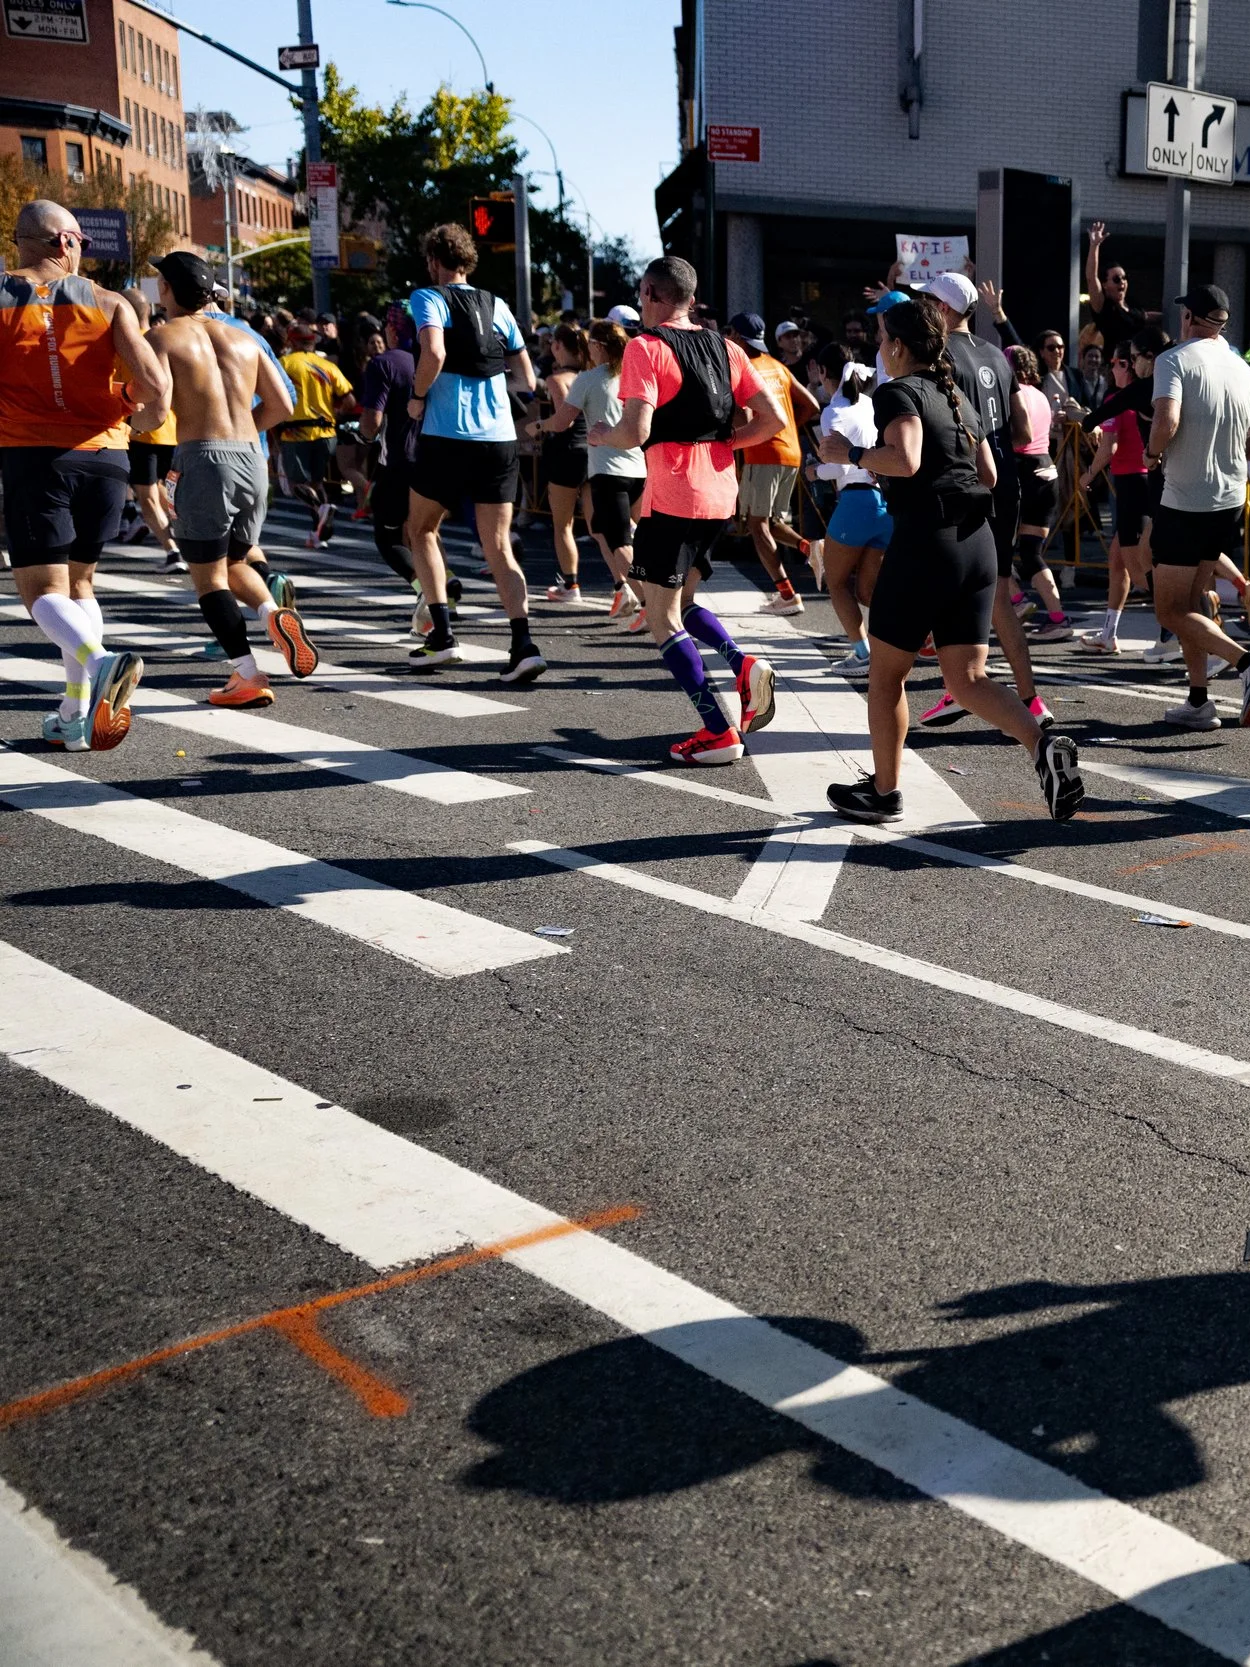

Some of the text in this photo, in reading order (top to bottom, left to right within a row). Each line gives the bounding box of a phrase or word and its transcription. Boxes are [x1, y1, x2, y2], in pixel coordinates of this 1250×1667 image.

[50, 0, 76, 11] ONLY
[34, 14, 78, 26] 2PM-7PM
[38, 25, 80, 36] MON-FRI
[711, 128, 753, 138] NO STANDING
[1152, 146, 1188, 167] ONLY
[1196, 154, 1229, 174] ONLY
[90, 240, 121, 253] TRANCE
[901, 240, 953, 255] KATIE
